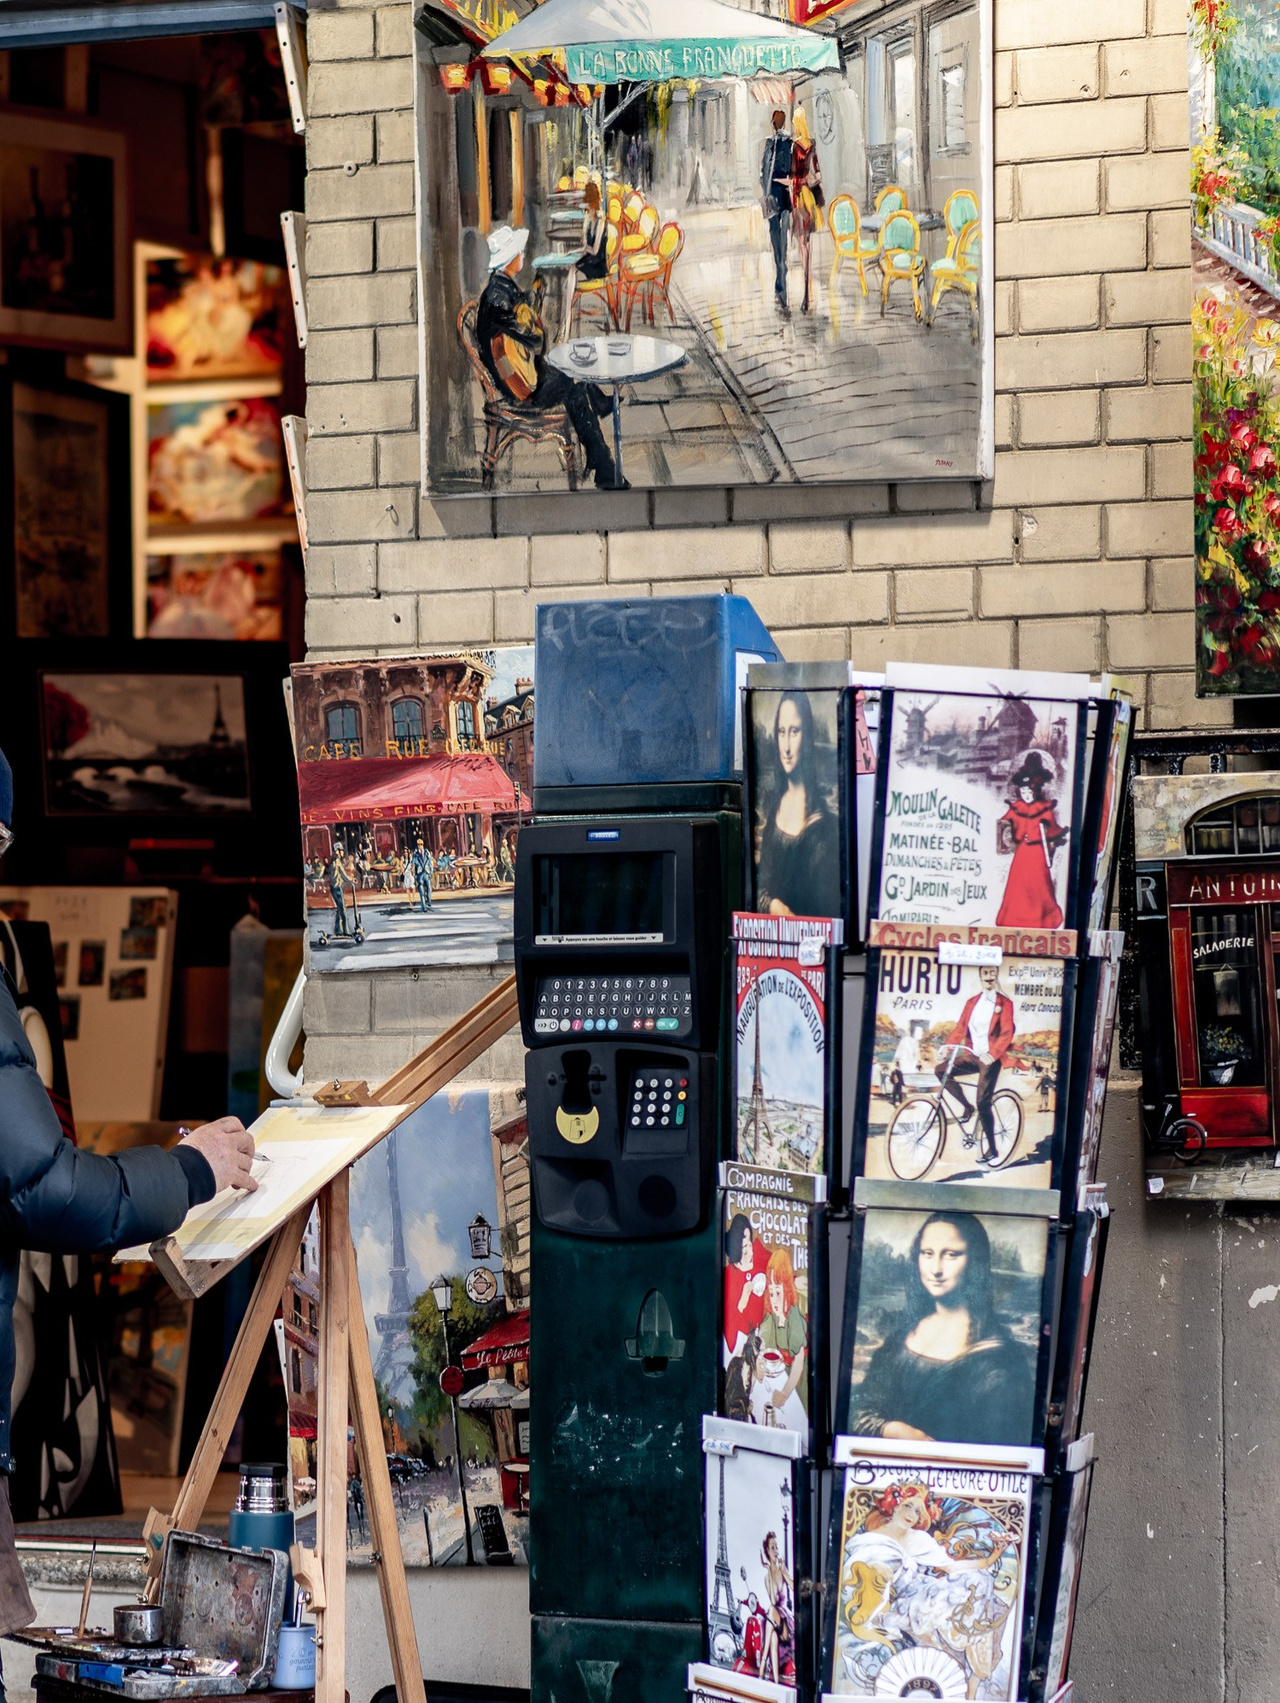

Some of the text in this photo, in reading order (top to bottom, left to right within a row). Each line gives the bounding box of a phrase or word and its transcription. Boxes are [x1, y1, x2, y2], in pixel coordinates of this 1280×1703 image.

[579, 50, 606, 76] LA
[305, 739, 431, 762] CAFE RUE
[333, 808, 384, 820] VINS
[447, 801, 481, 813] CAFE
[885, 788, 938, 817] MOULIN
[938, 796, 981, 835] GALETTE
[885, 852, 942, 871] DIMANCHES
[904, 876, 949, 902] JARDIN
[957, 879, 988, 905] JEUX
[879, 924, 961, 953] Cycles
[1193, 937, 1255, 959] SALADERIE
[879, 956, 962, 995] HURTU
[1014, 984, 1043, 997] MEMBRE
[892, 995, 933, 1011] PARIS
[728, 1167, 793, 1193] COMPAGNIE
[763, 1232, 790, 1246] ET DES
